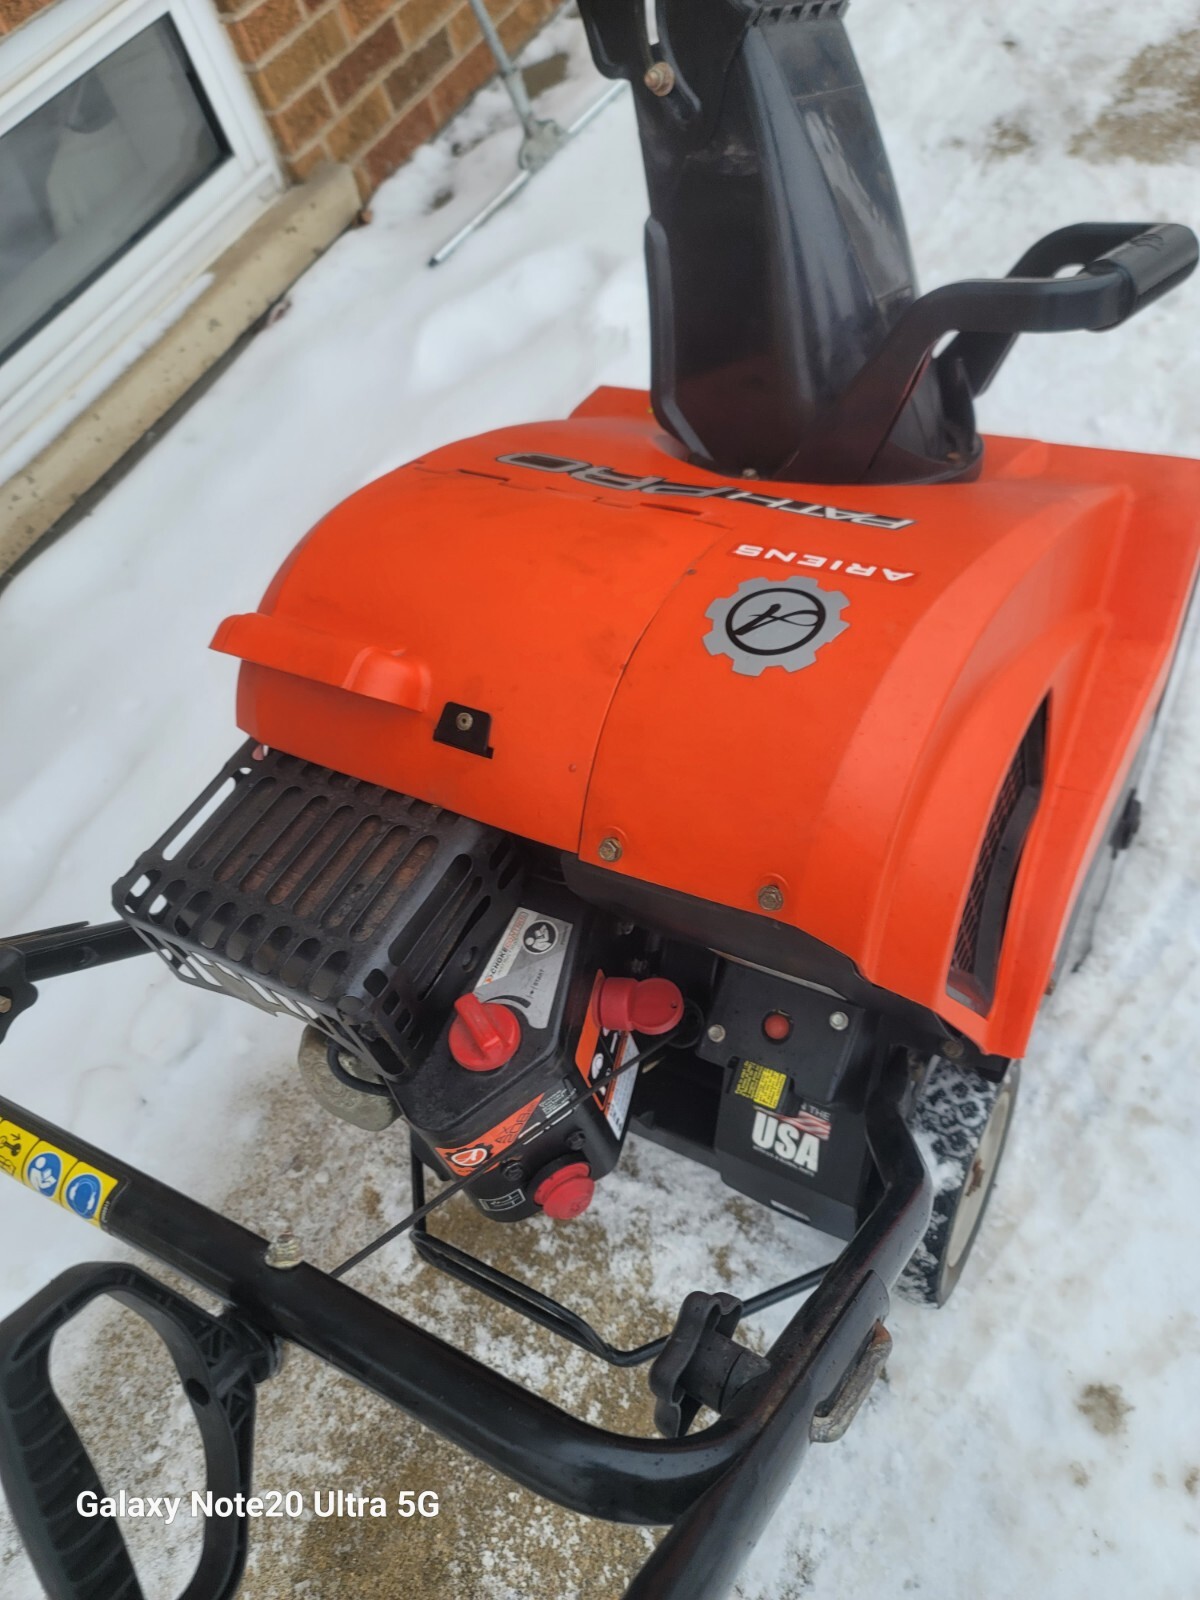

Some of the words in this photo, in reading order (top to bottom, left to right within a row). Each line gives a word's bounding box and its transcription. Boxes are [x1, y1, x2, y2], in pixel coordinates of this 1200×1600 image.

[735, 543, 915, 582] ARIENS
[809, 1105, 831, 1121] THE
[752, 1111, 820, 1173] USA
